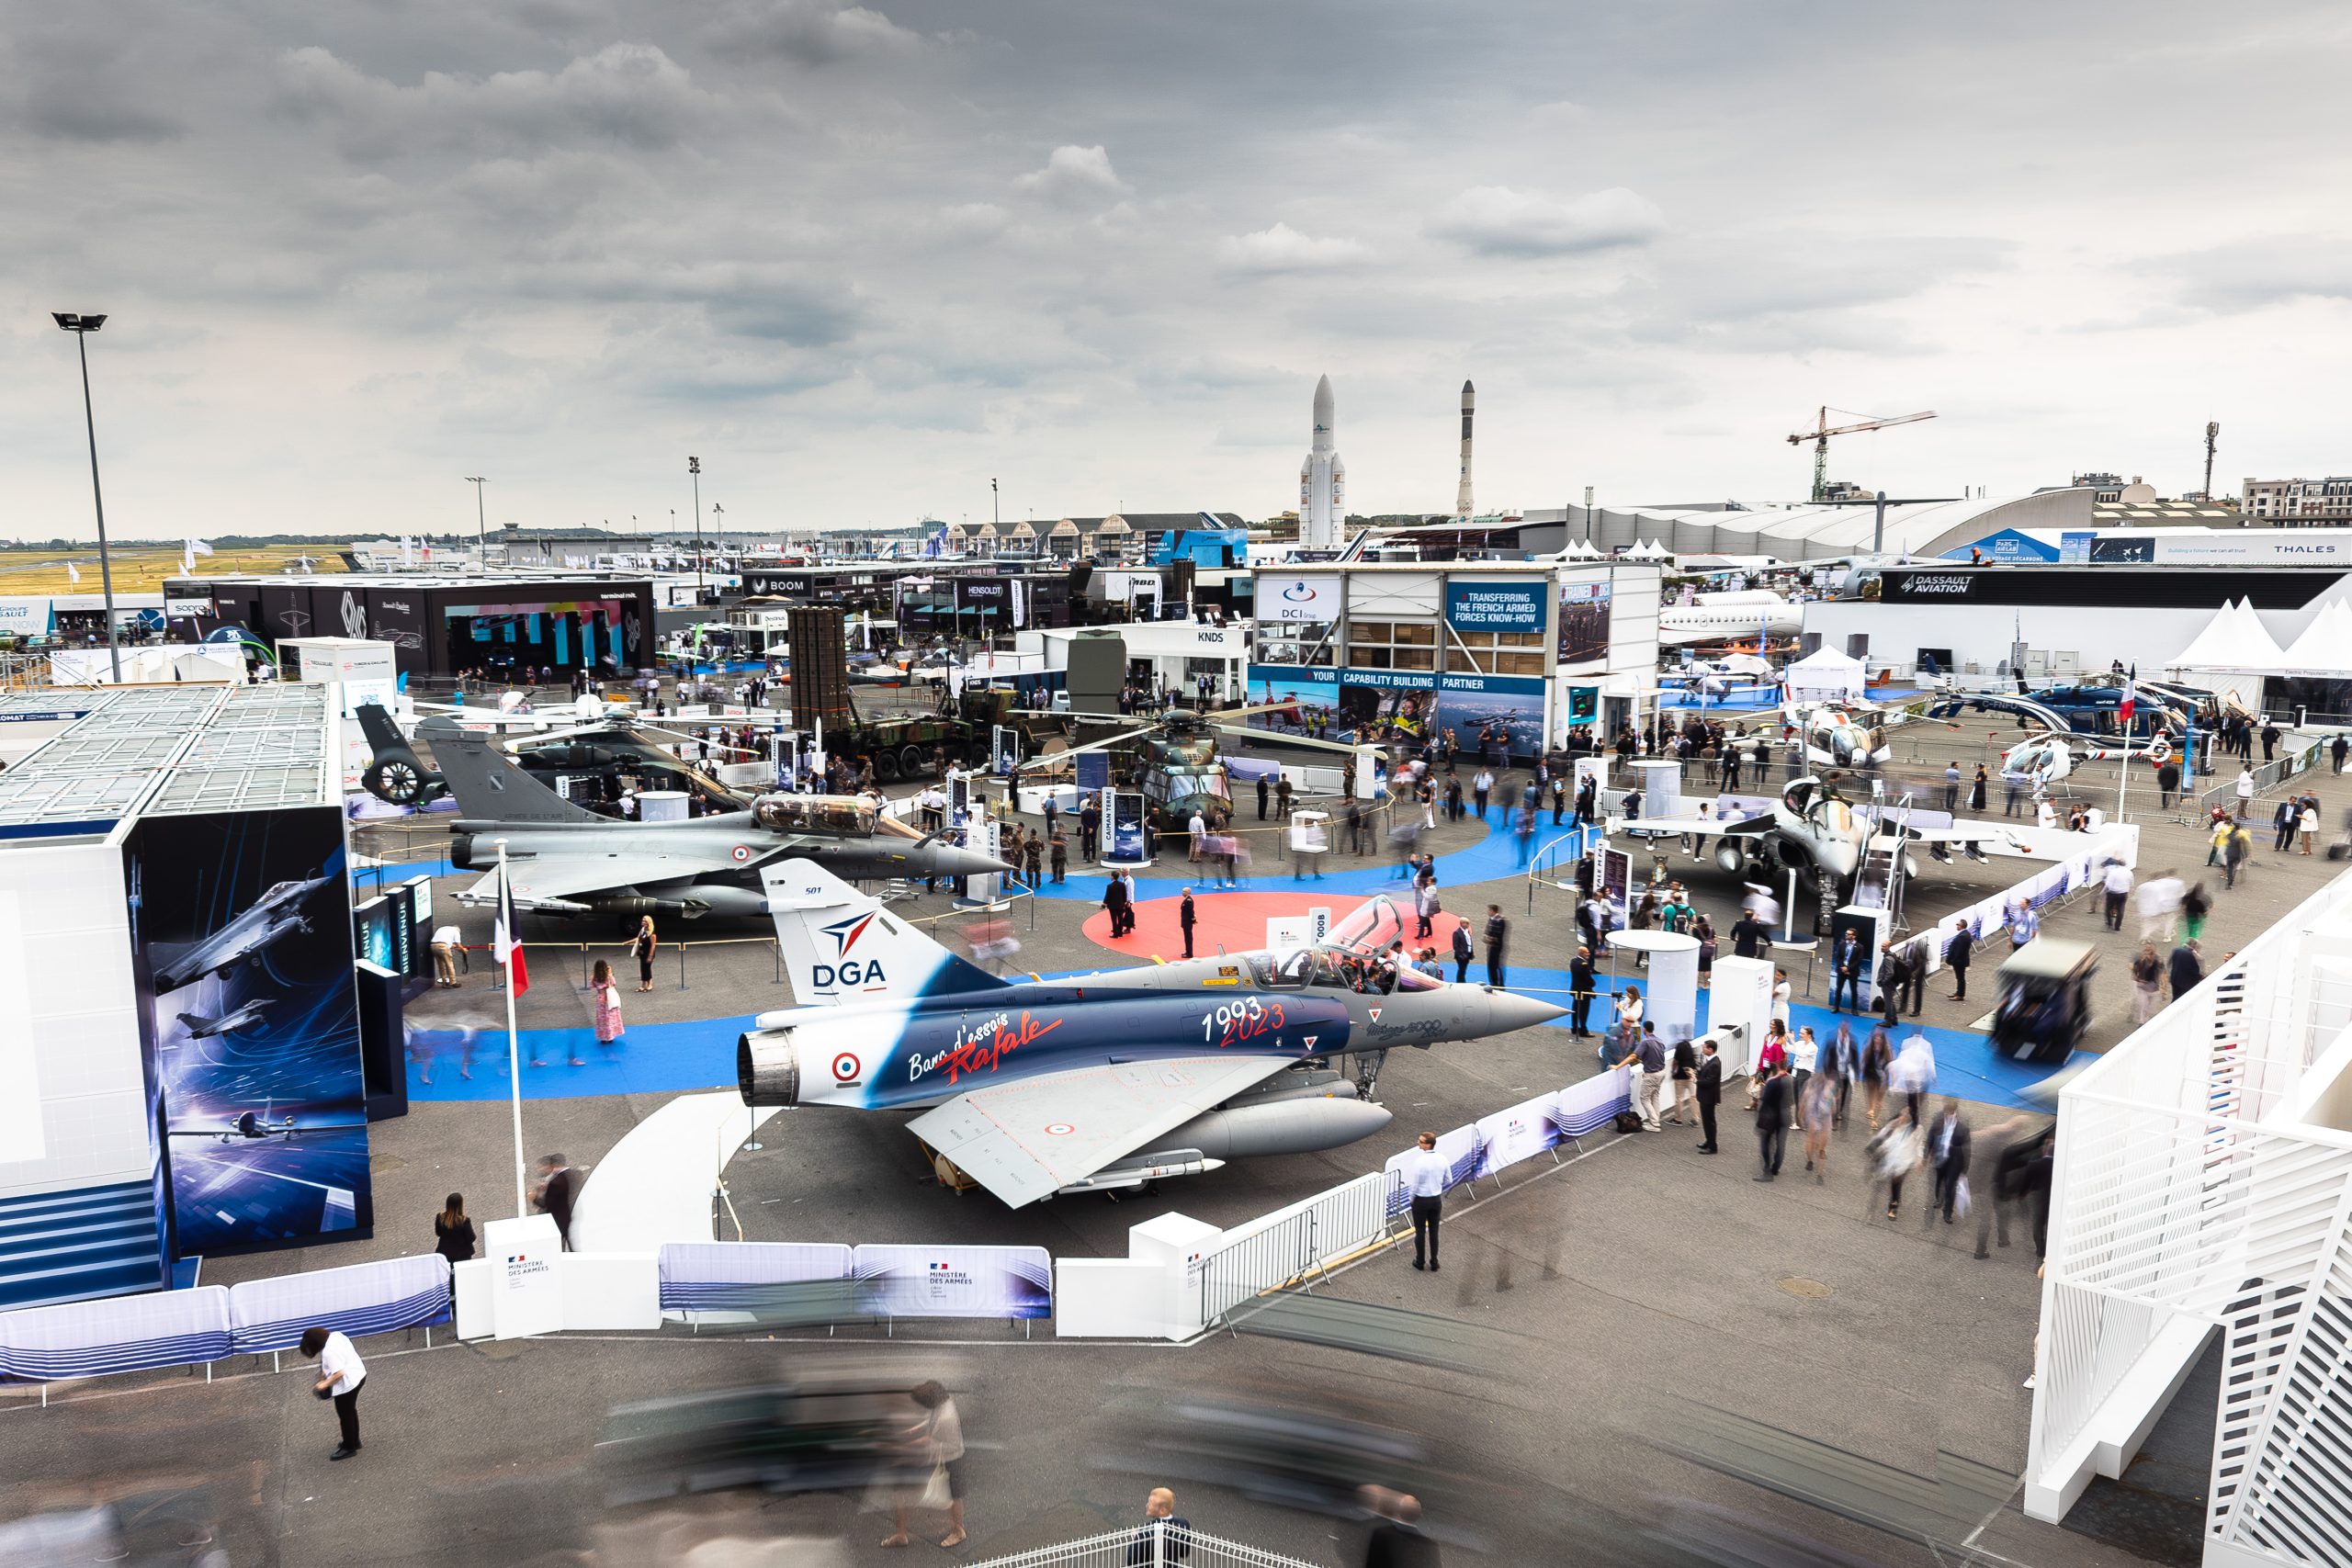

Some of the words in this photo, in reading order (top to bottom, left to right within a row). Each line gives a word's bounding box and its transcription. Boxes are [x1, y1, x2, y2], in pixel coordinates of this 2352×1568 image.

[1915, 576, 1973, 585] DASSAULT
[771, 581, 804, 591] BOOM
[968, 587, 1001, 595] HENSOLDT
[1914, 584, 1967, 593] AVIATION
[1468, 593, 1531, 603] TRANSFERRING
[1455, 603, 1471, 612] THE
[1472, 604, 1504, 613] FRENCH
[1506, 604, 1536, 613] ARMED
[1282, 609, 1303, 618] DCI
[1455, 613, 1487, 622] FORCES
[1487, 614, 1535, 623] KNOW-HOW
[1198, 632, 1224, 643] KNDS
[1313, 671, 1335, 681] YOUR
[1343, 673, 1391, 685] CAPABILITY
[1393, 677, 1433, 688] BUILDING
[1442, 679, 1484, 689] PARTNER
[400, 901, 409, 974] BIENVENUE
[813, 959, 886, 987] DGA
[1202, 996, 1262, 1042] 1993
[1220, 1003, 1285, 1048] 2023
[909, 1049, 948, 1082] Banc
[955, 1012, 1009, 1051] d'essais
[935, 1010, 1063, 1087] Rafale
[523, 1265, 549, 1274] ARMÉES
